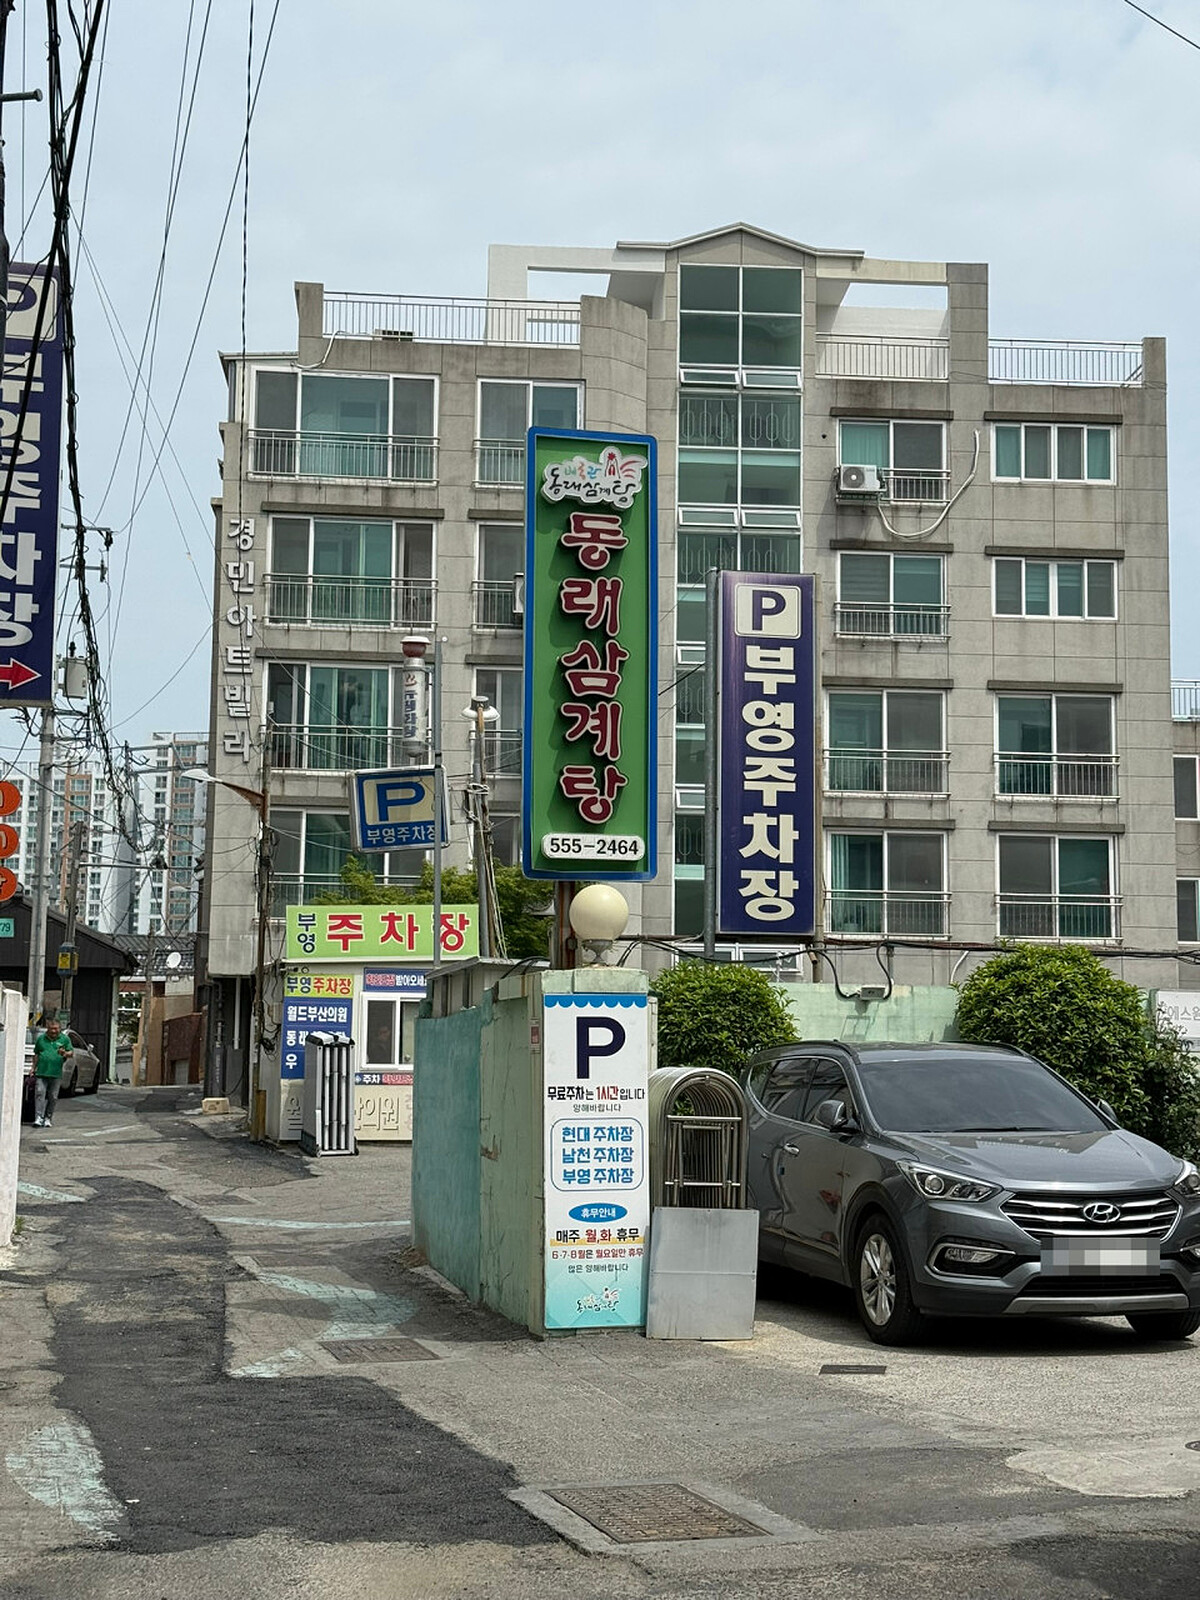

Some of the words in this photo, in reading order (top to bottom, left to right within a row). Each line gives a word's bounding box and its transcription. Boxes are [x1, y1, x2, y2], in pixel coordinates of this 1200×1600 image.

[752, 590, 786, 631] P
[223, 518, 257, 763] 경민아트빌라
[561, 512, 629, 824] 동래삼계탕
[738, 645, 799, 922] 부영주차장
[376, 781, 426, 822] P
[550, 838, 639, 855] 555-2464
[297, 913, 317, 953] 부영
[327, 912, 470, 952] 주차장
[288, 1006, 347, 1022] 월드부산의원
[576, 1016, 626, 1079] P
[547, 1086, 594, 1101] 무료주차는
[562, 1127, 590, 1143] 현대
[593, 1126, 634, 1142] 주차장
[562, 1147, 590, 1164] 남천
[593, 1147, 634, 1163] 주차장
[562, 1168, 591, 1184] 부영
[593, 1168, 634, 1184] 주차장
[581, 1207, 616, 1218] 휴무안내
[556, 1229, 580, 1243] 매주
[585, 1228, 612, 1243] 월,화
[616, 1227, 640, 1241] 휴무
